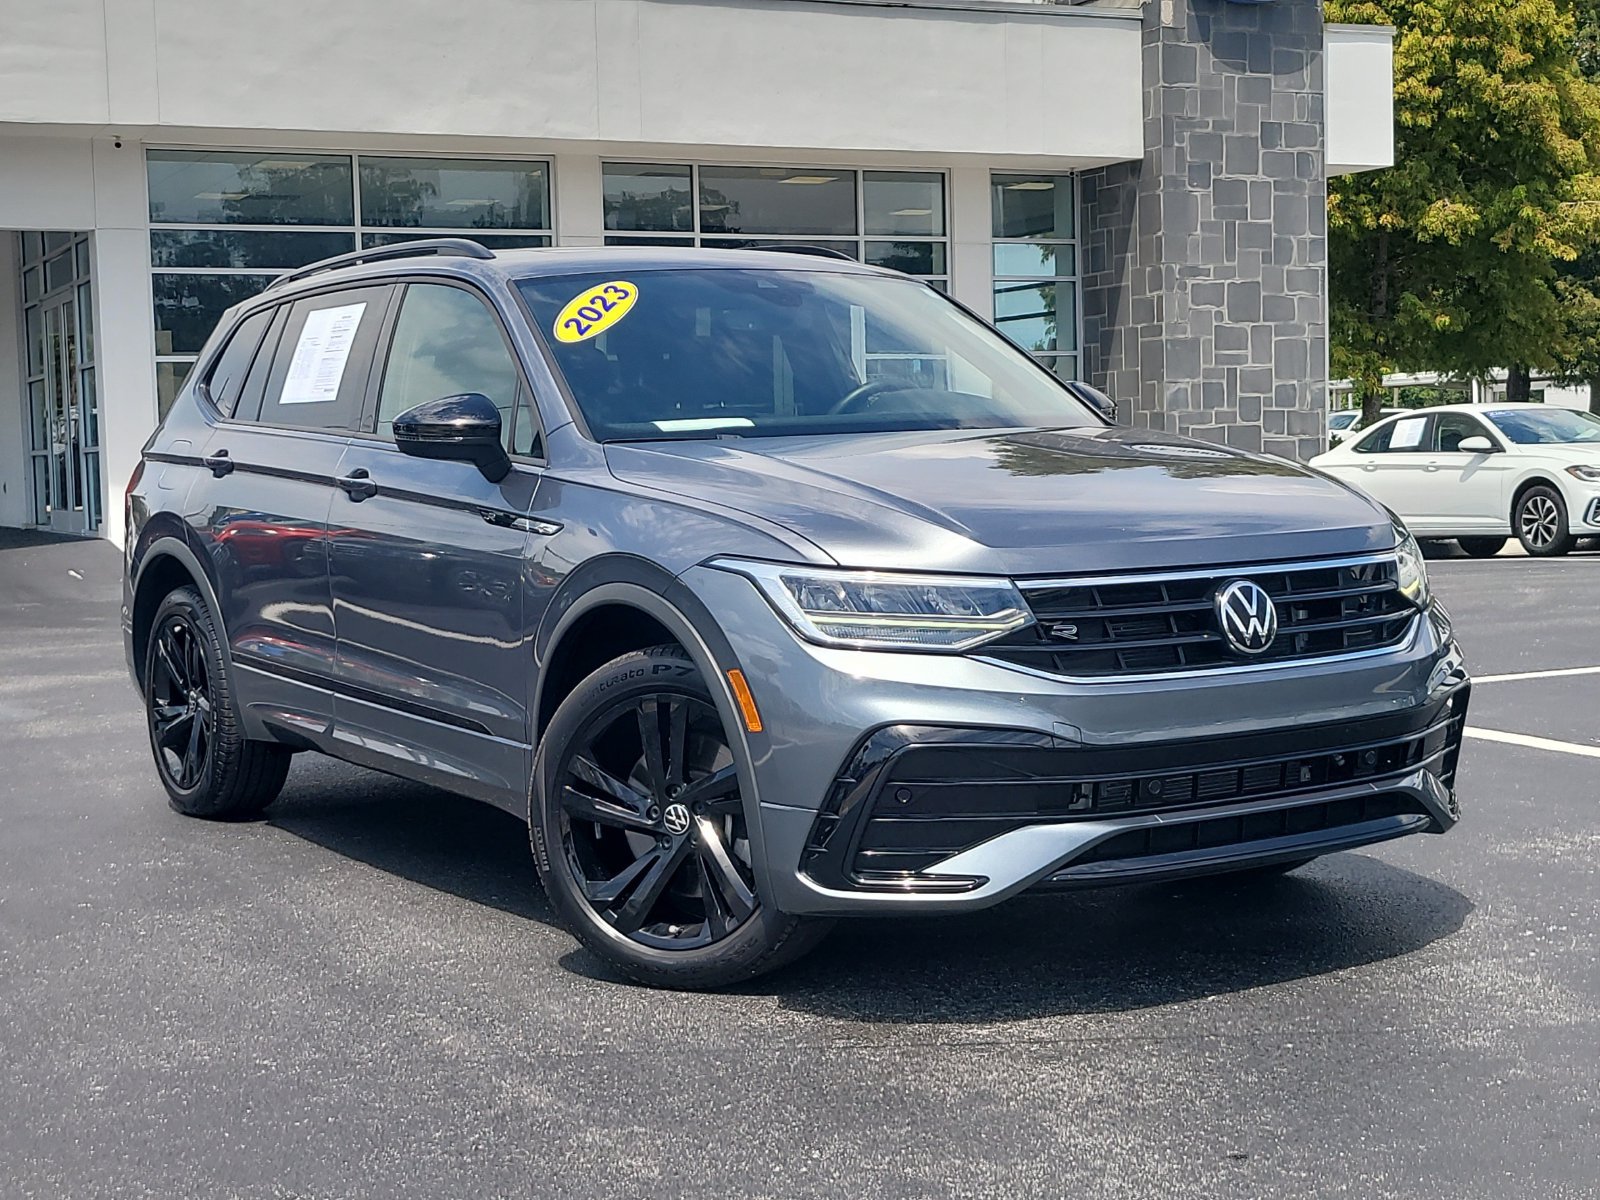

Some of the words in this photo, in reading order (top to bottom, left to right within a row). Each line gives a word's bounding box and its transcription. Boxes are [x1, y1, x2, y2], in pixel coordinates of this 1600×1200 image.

[564, 285, 629, 336] 2023
[1051, 624, 1078, 639] R
[1219, 580, 1278, 654] VW
[651, 663, 696, 677] P7
[664, 804, 690, 835] VW
